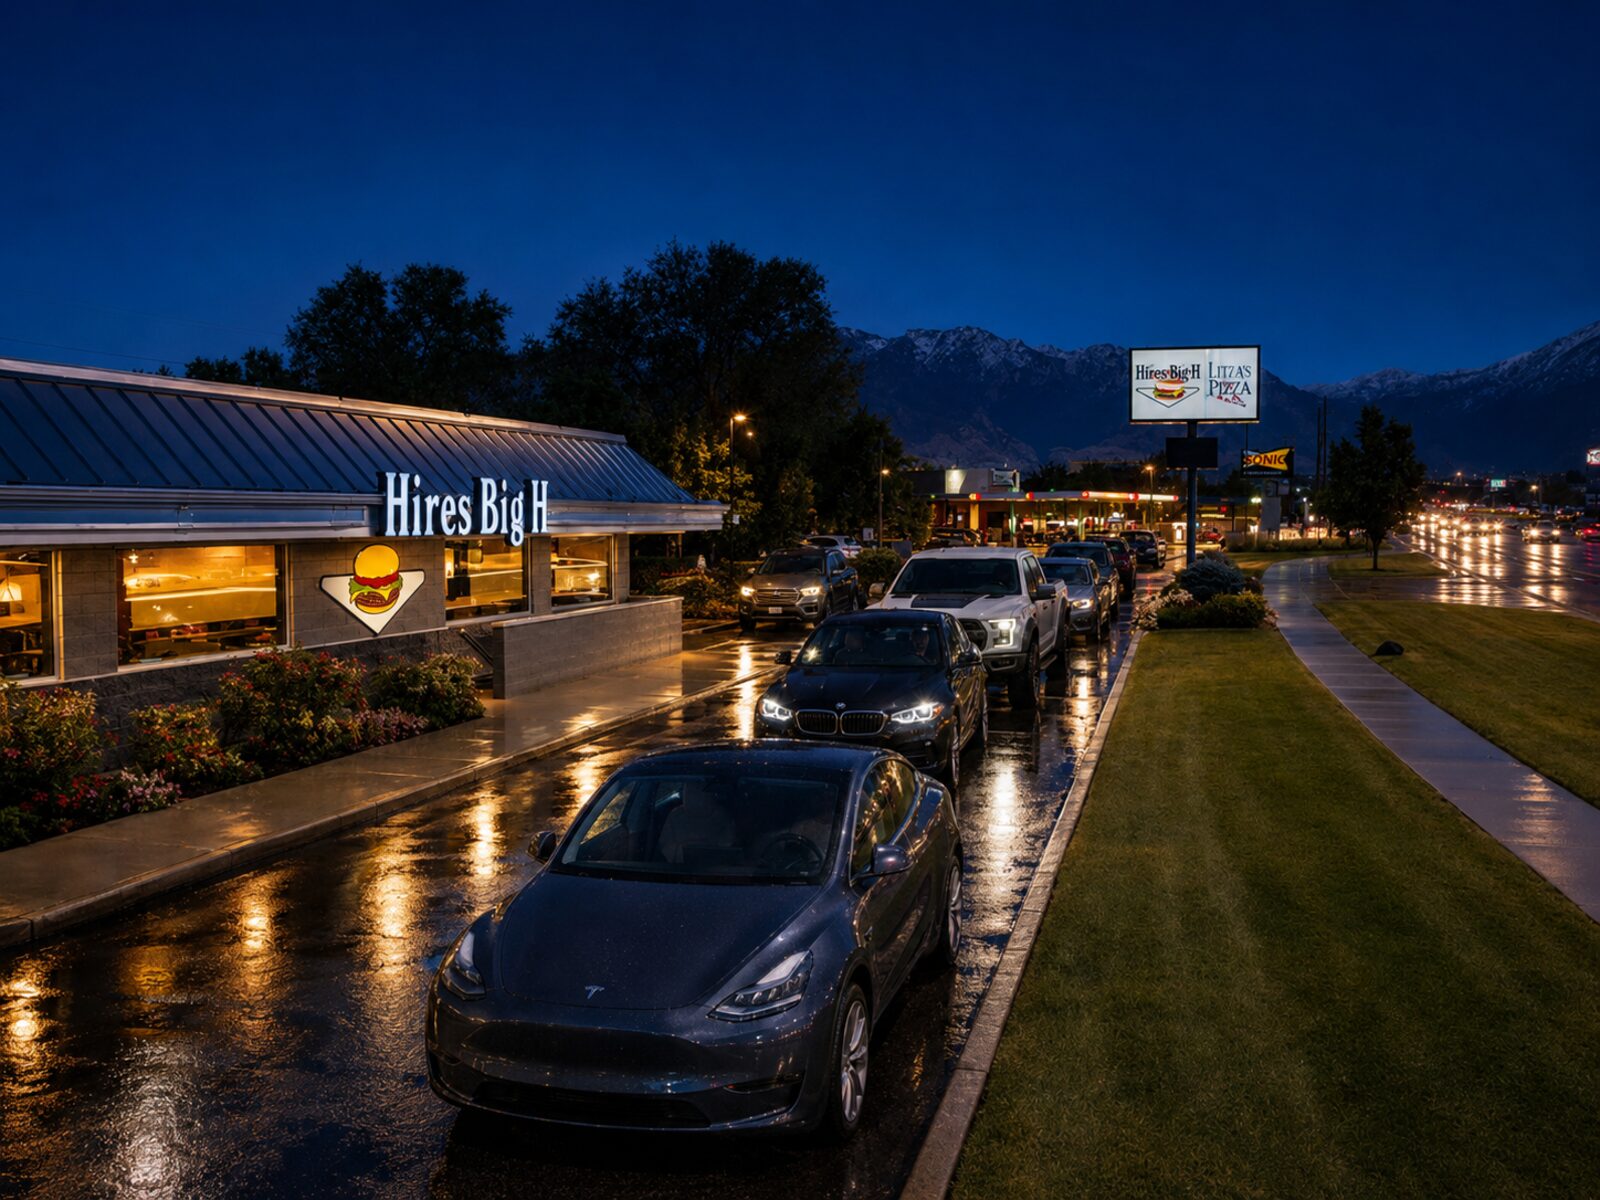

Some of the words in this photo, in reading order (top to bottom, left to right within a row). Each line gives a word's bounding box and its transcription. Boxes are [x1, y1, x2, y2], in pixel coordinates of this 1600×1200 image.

[1136, 364, 1168, 380] Hires
[1170, 364, 1189, 383] Big
[1191, 364, 1200, 379] H
[1207, 379, 1251, 396] PIZZA
[1245, 454, 1286, 465] SONIC
[384, 472, 472, 537] Hires
[480, 477, 524, 547] Big
[531, 479, 549, 534] H
